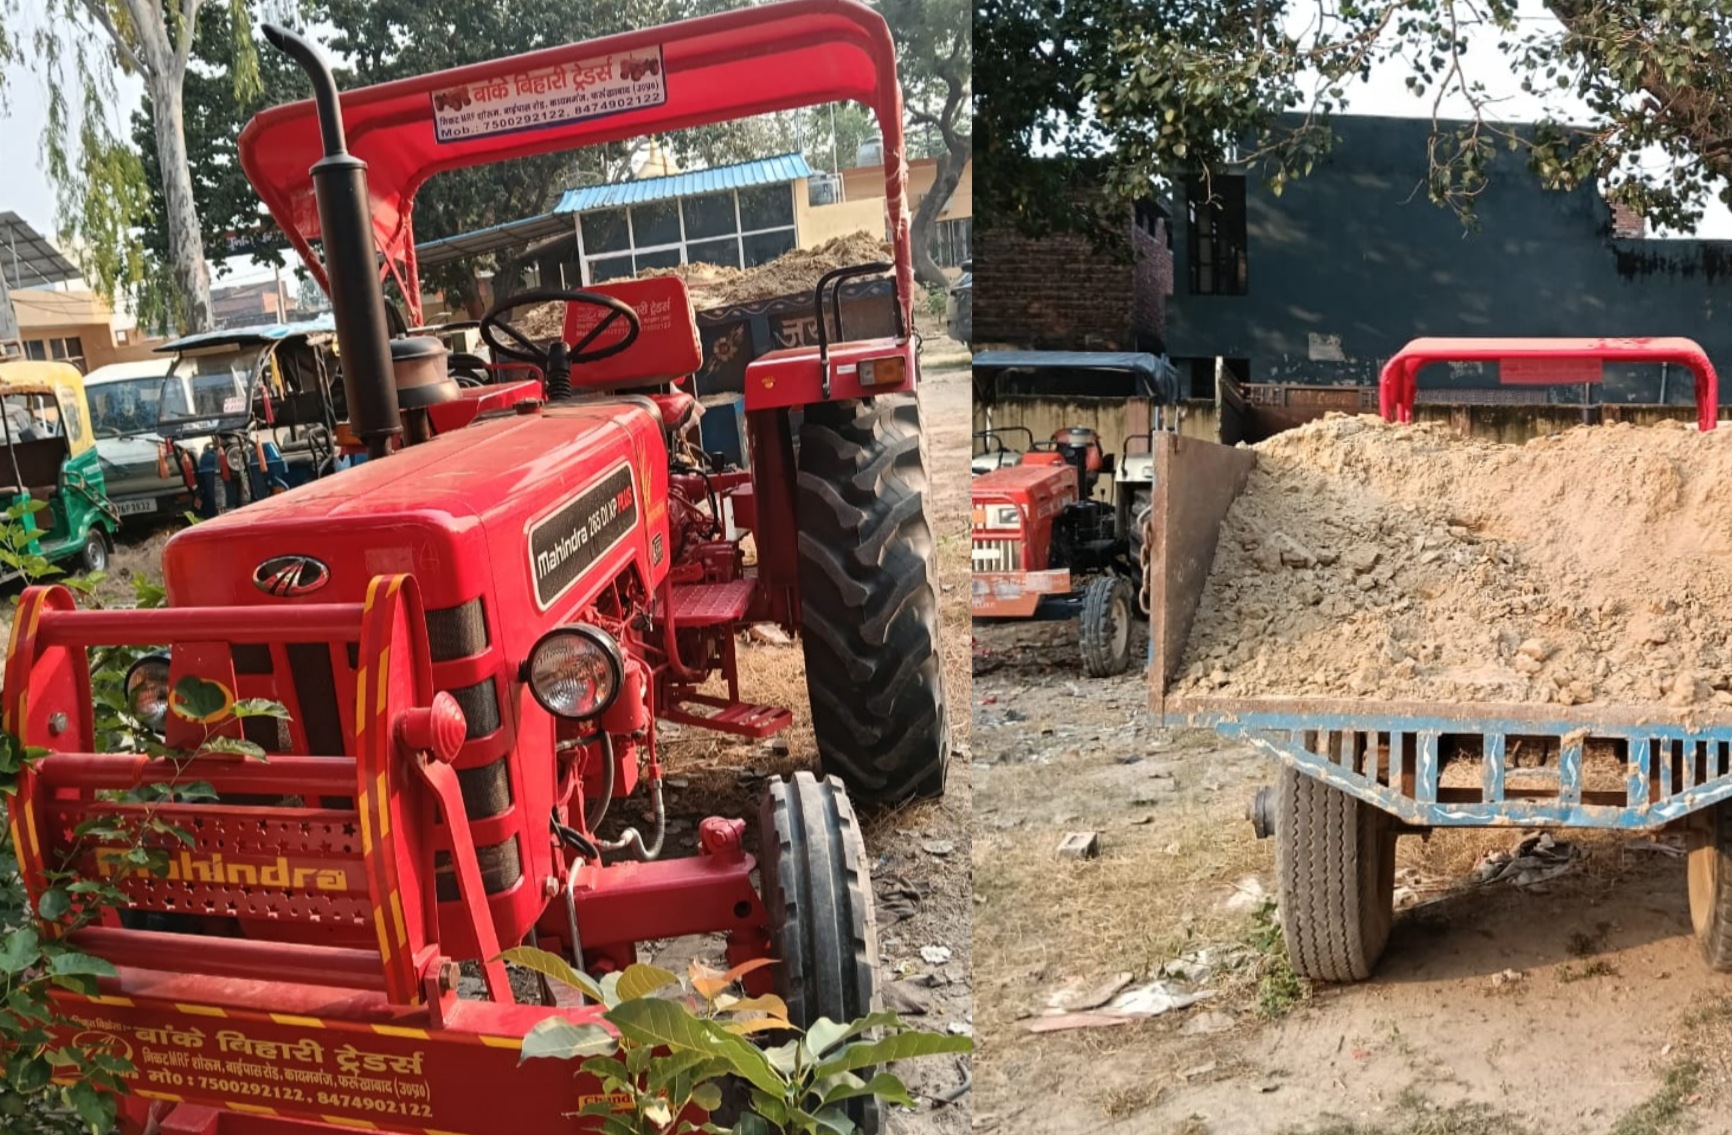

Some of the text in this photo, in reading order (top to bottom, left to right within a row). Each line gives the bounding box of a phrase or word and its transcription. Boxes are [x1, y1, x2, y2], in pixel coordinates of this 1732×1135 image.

[514, 66, 567, 96] बिहारी
[572, 57, 613, 91] ट्रेडर्स
[574, 93, 660, 115] 8474902122
[537, 525, 588, 579] Mahindra
[216, 1030, 325, 1063] बिहारी
[334, 1043, 425, 1075] ट्रेडर्स
[317, 1091, 433, 1118] 8474902122
